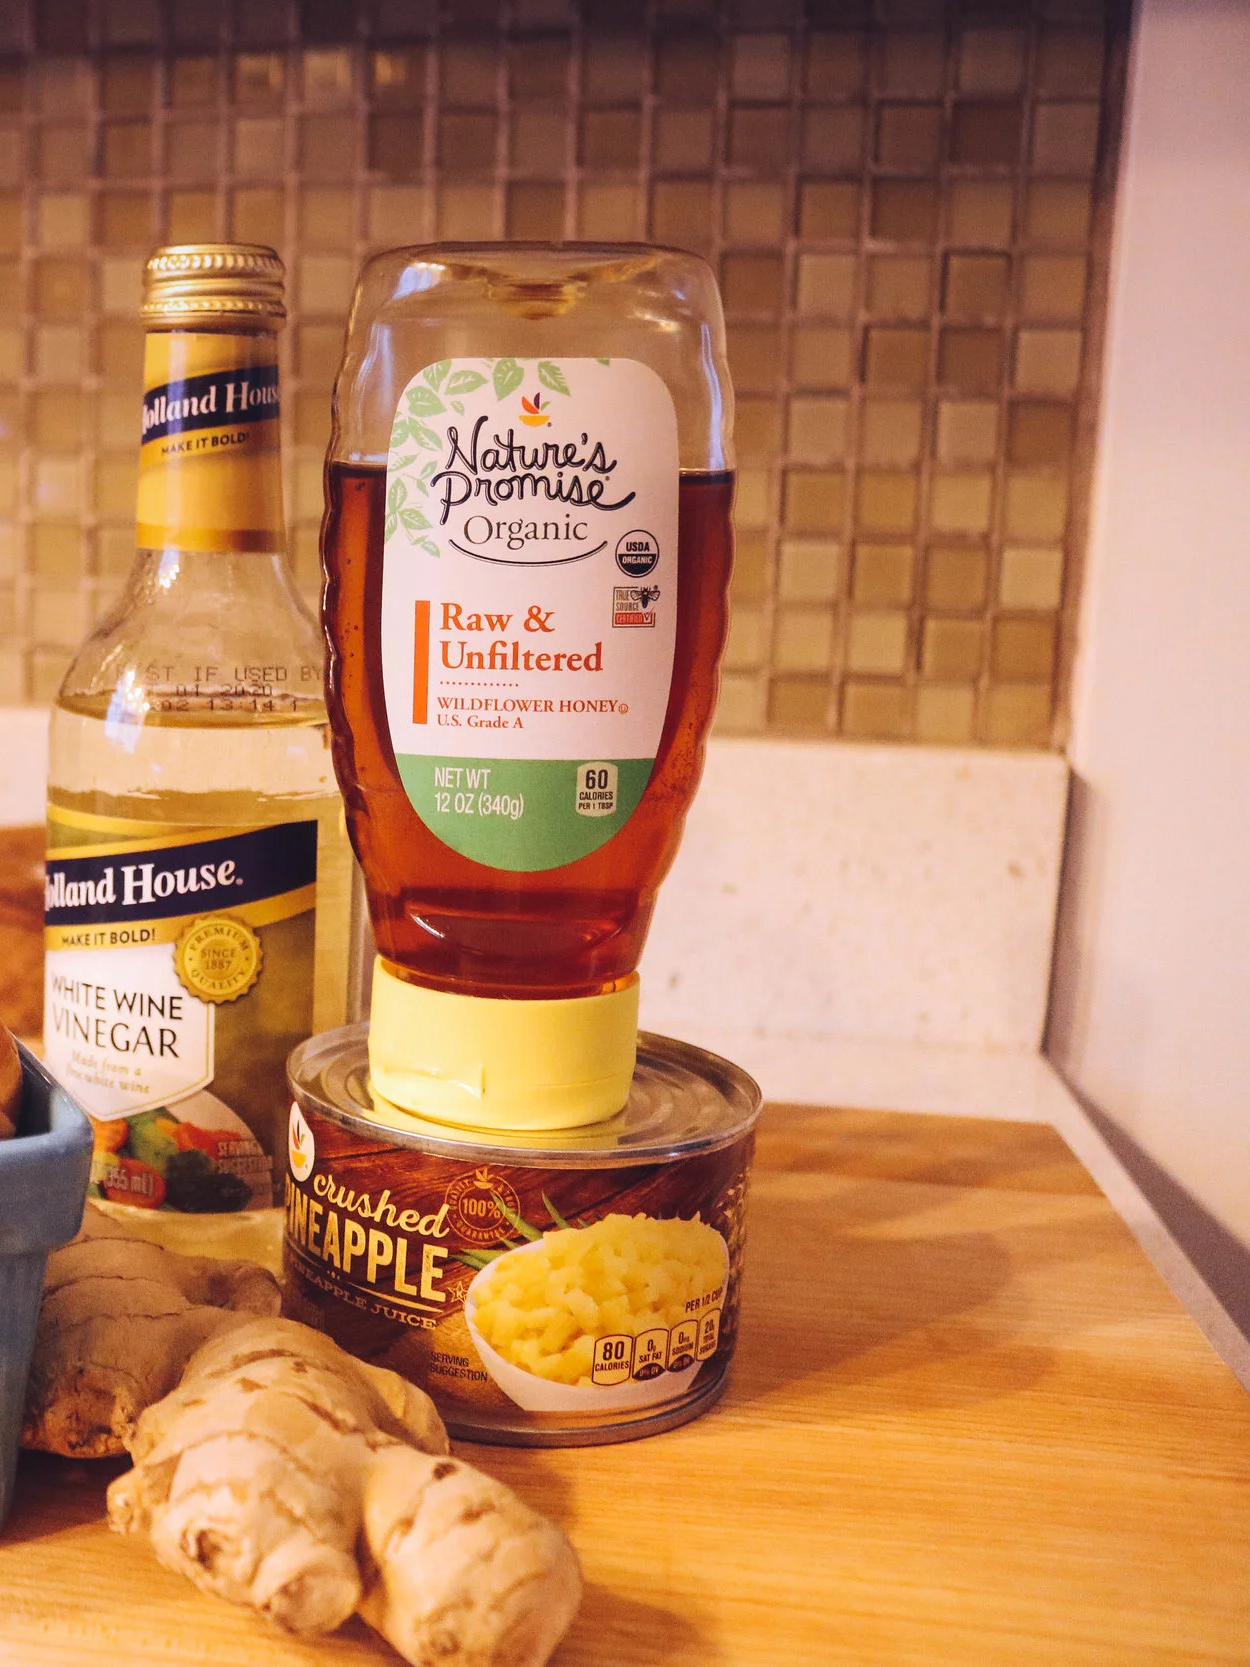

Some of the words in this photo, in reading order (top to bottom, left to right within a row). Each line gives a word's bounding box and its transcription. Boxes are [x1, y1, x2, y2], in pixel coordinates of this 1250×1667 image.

[162, 440, 193, 457] MAKE
[196, 437, 209, 450] IT
[445, 415, 617, 475] Nature's
[430, 471, 636, 526] Promise
[463, 513, 588, 551] Organic
[626, 541, 650, 552] USDA
[622, 555, 653, 564] ORGANIC
[439, 602, 513, 632] Raw
[523, 605, 555, 632] &
[439, 640, 603, 672] Unfiltered
[194, 666, 219, 682] IF
[235, 666, 287, 683] USED
[437, 696, 553, 712] WILDFLOWER
[559, 699, 619, 713] HONEY
[437, 714, 462, 727] U.S.
[467, 716, 508, 729] Grade
[513, 717, 524, 729] A
[434, 767, 463, 788] NET
[467, 769, 491, 789] WT
[585, 769, 608, 789] 60
[579, 791, 613, 801] CALORIES
[579, 802, 592, 810] PER
[598, 802, 613, 810] TBSP
[434, 793, 450, 812] 12
[455, 794, 474, 813] OZ
[478, 793, 524, 820] (340g)
[62, 933, 90, 946] MAKE
[94, 932, 106, 945] IT
[110, 928, 156, 945] BOLD!
[190, 927, 249, 951] PREMIUM
[201, 948, 235, 958] SINCE
[191, 970, 245, 989] QUALITY
[51, 973, 106, 1011] WHITE
[114, 989, 183, 1020] WINE
[52, 1003, 179, 1058] VINEGAR
[102, 1057, 128, 1074] from
[119, 1081, 150, 1094] wine
[313, 1173, 450, 1238] crushed
[462, 1198, 501, 1218] 100%
[685, 1298, 700, 1313] PER
[712, 1286, 723, 1302] CUP
[370, 1303, 437, 1330] JUICE
[431, 1351, 469, 1367] SERVING
[602, 1341, 625, 1361] 80
[639, 1354, 650, 1363] SAT
[652, 1351, 662, 1361] FAT
[430, 1361, 488, 1382] SUGGESTION
[594, 1361, 630, 1371] CALORIES
